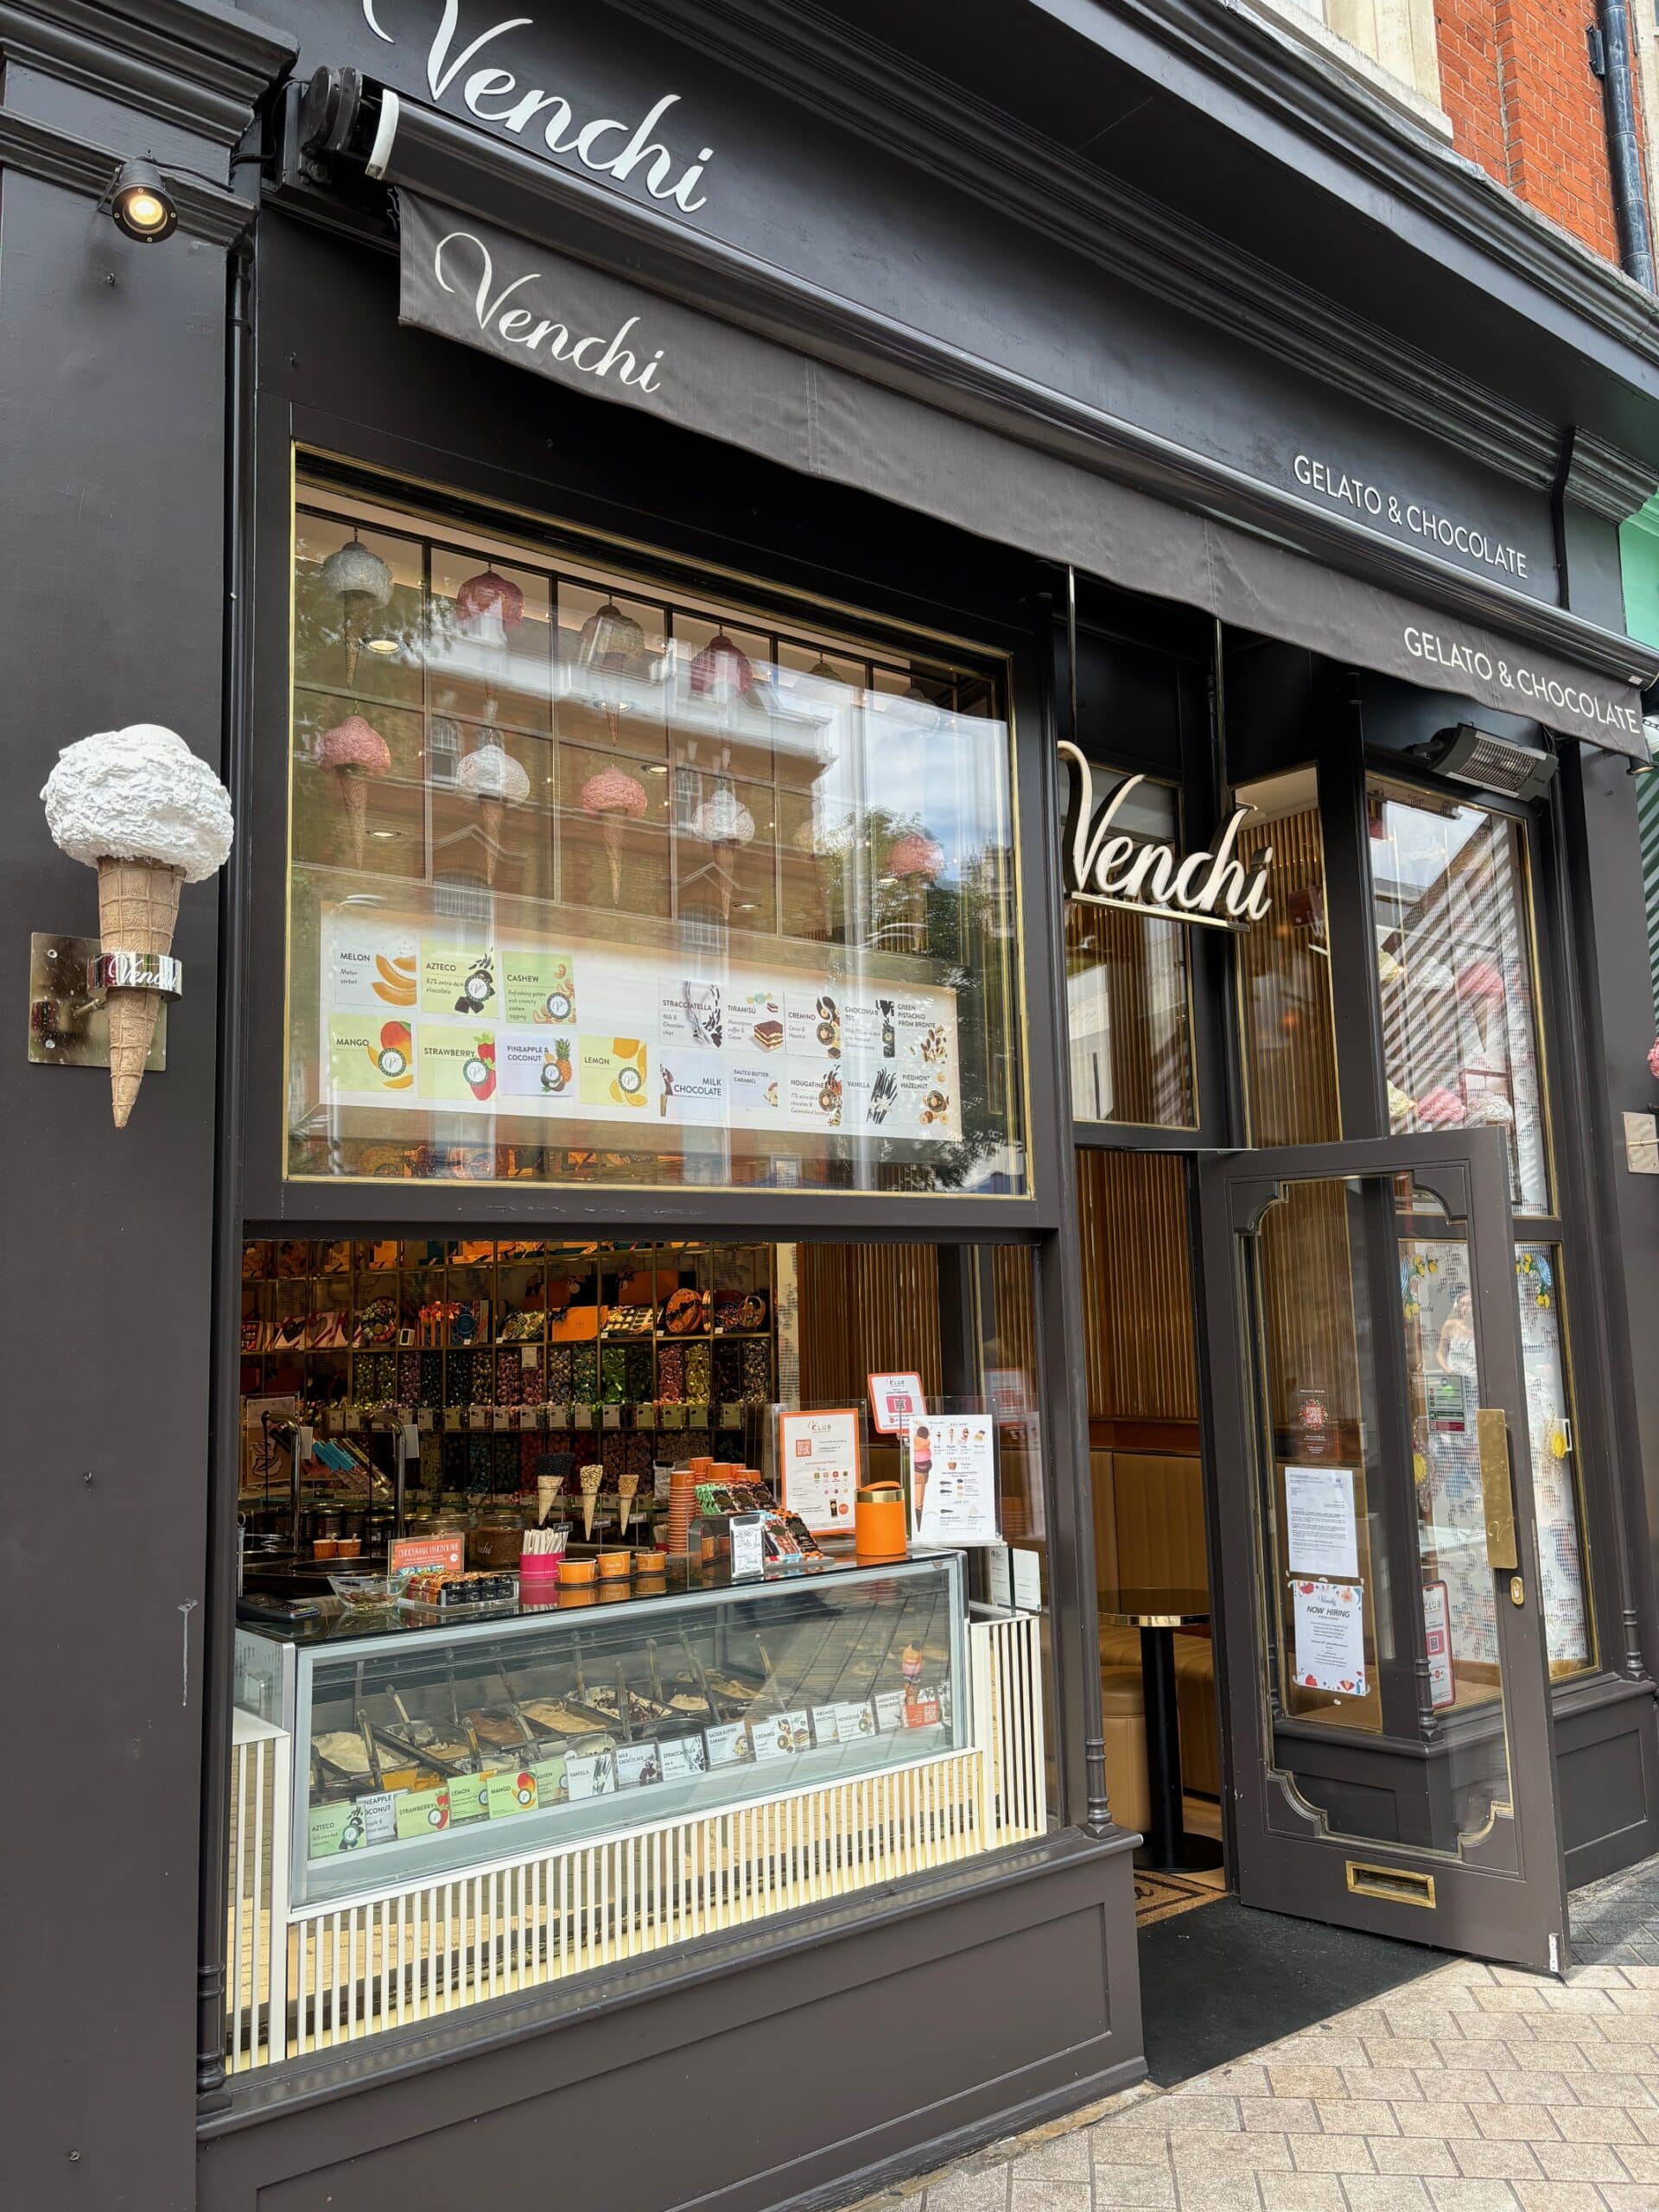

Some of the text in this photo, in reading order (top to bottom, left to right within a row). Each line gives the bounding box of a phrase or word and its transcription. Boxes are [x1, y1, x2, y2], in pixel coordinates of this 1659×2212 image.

[364, 0, 714, 213] Venchi
[435, 232, 663, 393] Venchi
[1294, 454, 1529, 580] GELATO & CHOCOLATE
[1404, 626, 1641, 734] GELATO & CHOCOLATE
[1057, 741, 1273, 920] Venchi
[340, 951, 371, 962] MELON
[426, 962, 457, 972] AZTECO
[506, 974, 539, 983] CASHEW
[788, 1011, 817, 1020] CREMINO
[336, 1038, 370, 1047] MANGO
[423, 1046, 476, 1058] STRAWBERRY
[507, 1045, 543, 1053] PINEAPPLE
[507, 1054, 543, 1063] COCONUT
[584, 1057, 610, 1065] LEMON
[702, 1077, 722, 1086] MILK
[791, 1078, 825, 1089] NOUGATINE
[847, 1080, 871, 1089] VANILLA
[674, 1084, 722, 1096] CHOCOLATE
[1306, 1605, 1325, 1615] NOW
[1326, 1608, 1351, 1618] HIRING
[451, 1787, 471, 1796] LEMON
[491, 1785, 512, 1795] MANGO
[364, 1794, 391, 1806] NEAPPLE
[364, 1804, 391, 1815] OCONUT
[311, 1822, 334, 1832] AZTECO
